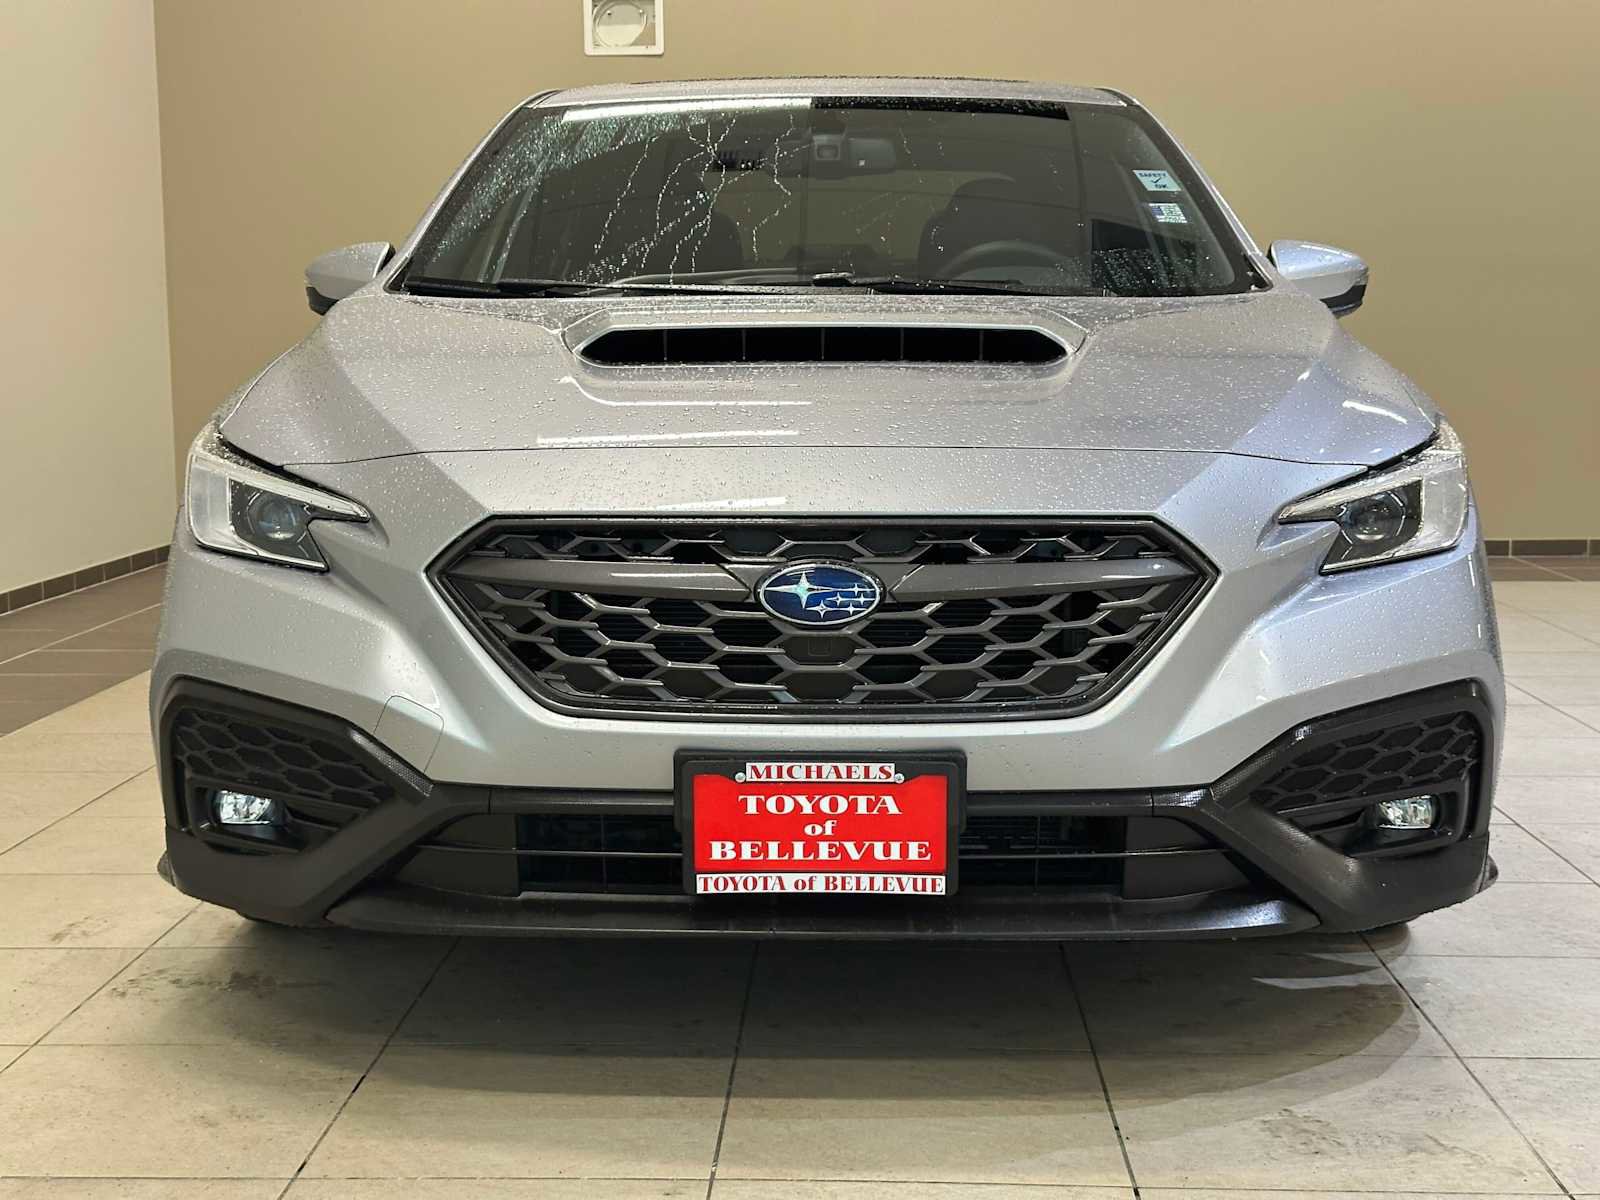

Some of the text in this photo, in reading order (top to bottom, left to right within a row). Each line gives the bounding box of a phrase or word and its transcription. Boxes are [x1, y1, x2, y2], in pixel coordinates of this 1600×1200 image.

[750, 764, 893, 780] MICHAELS
[738, 794, 902, 815] TOYOTA
[803, 819, 837, 837] of
[708, 840, 932, 861] BELLEVUE
[698, 875, 944, 894] TOYOTA of BELLEVUE
